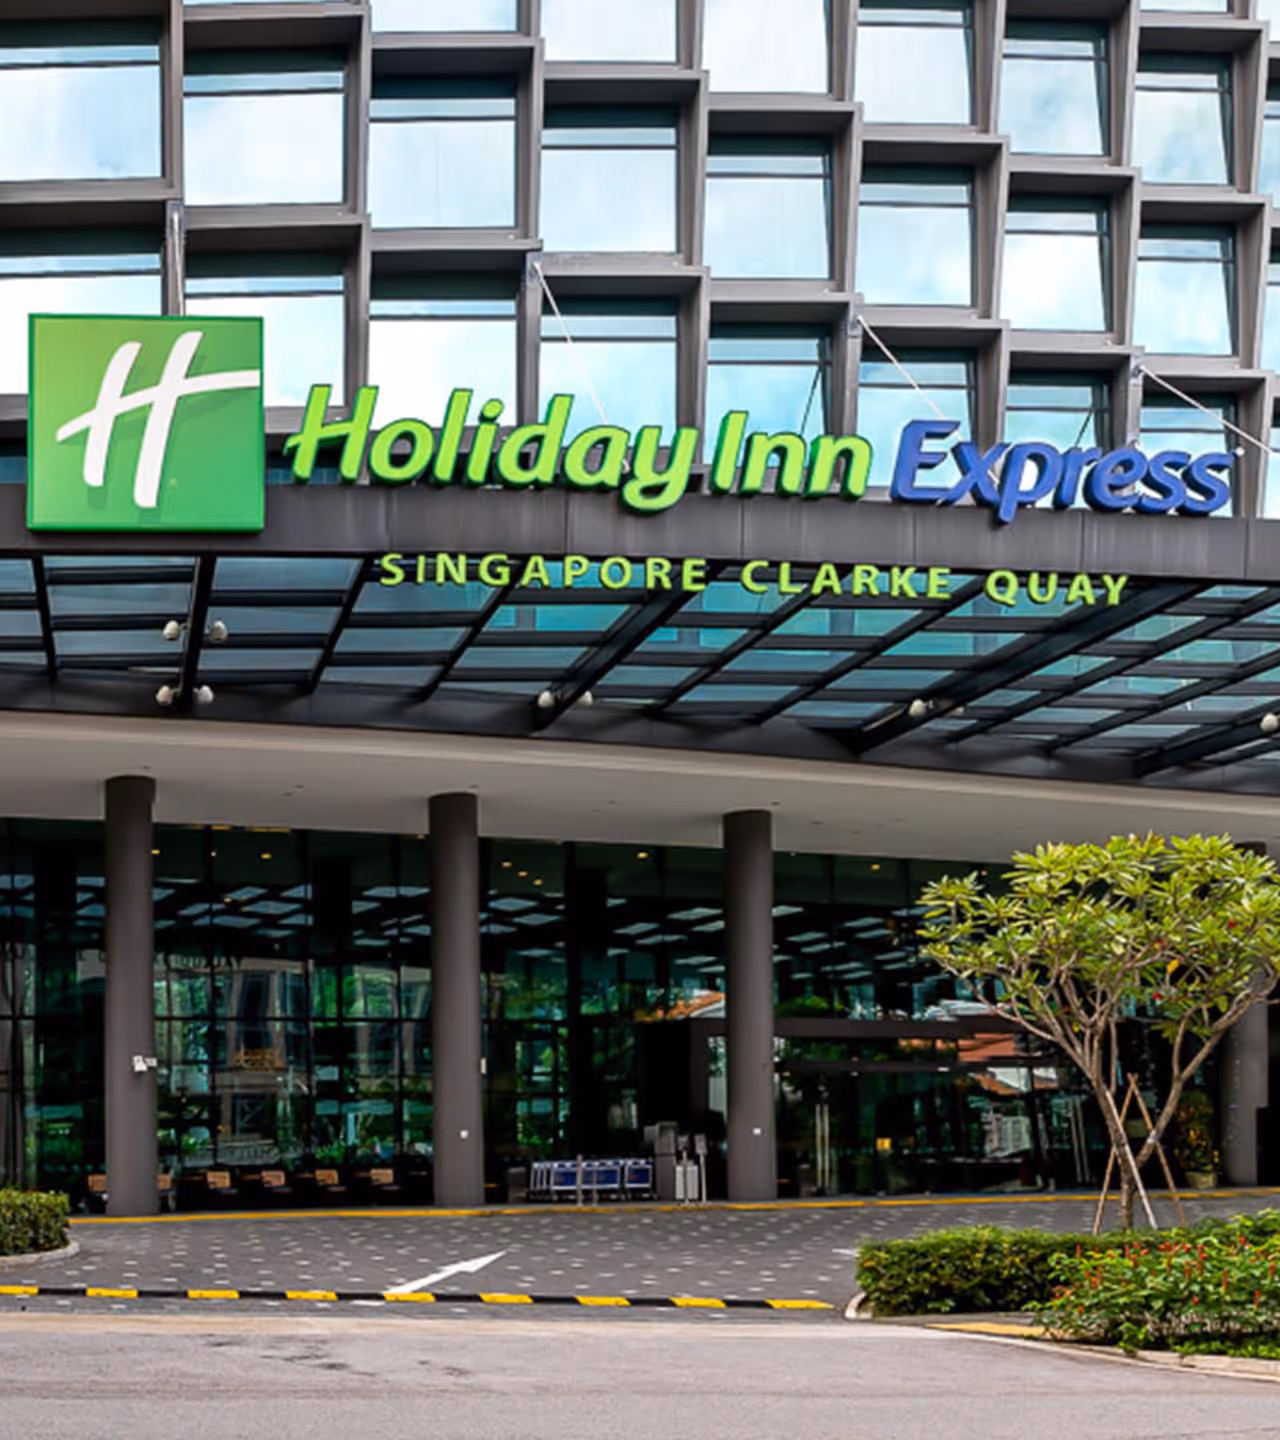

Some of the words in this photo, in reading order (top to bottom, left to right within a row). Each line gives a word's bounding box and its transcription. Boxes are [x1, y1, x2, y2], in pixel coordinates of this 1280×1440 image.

[56, 330, 261, 508] H
[283, 383, 699, 513] Holiday
[709, 410, 873, 501] Inn
[890, 419, 1236, 526] Express
[379, 552, 708, 592] SINGAPORE
[740, 559, 952, 600] CLARKE
[984, 569, 1129, 606] QUAY
